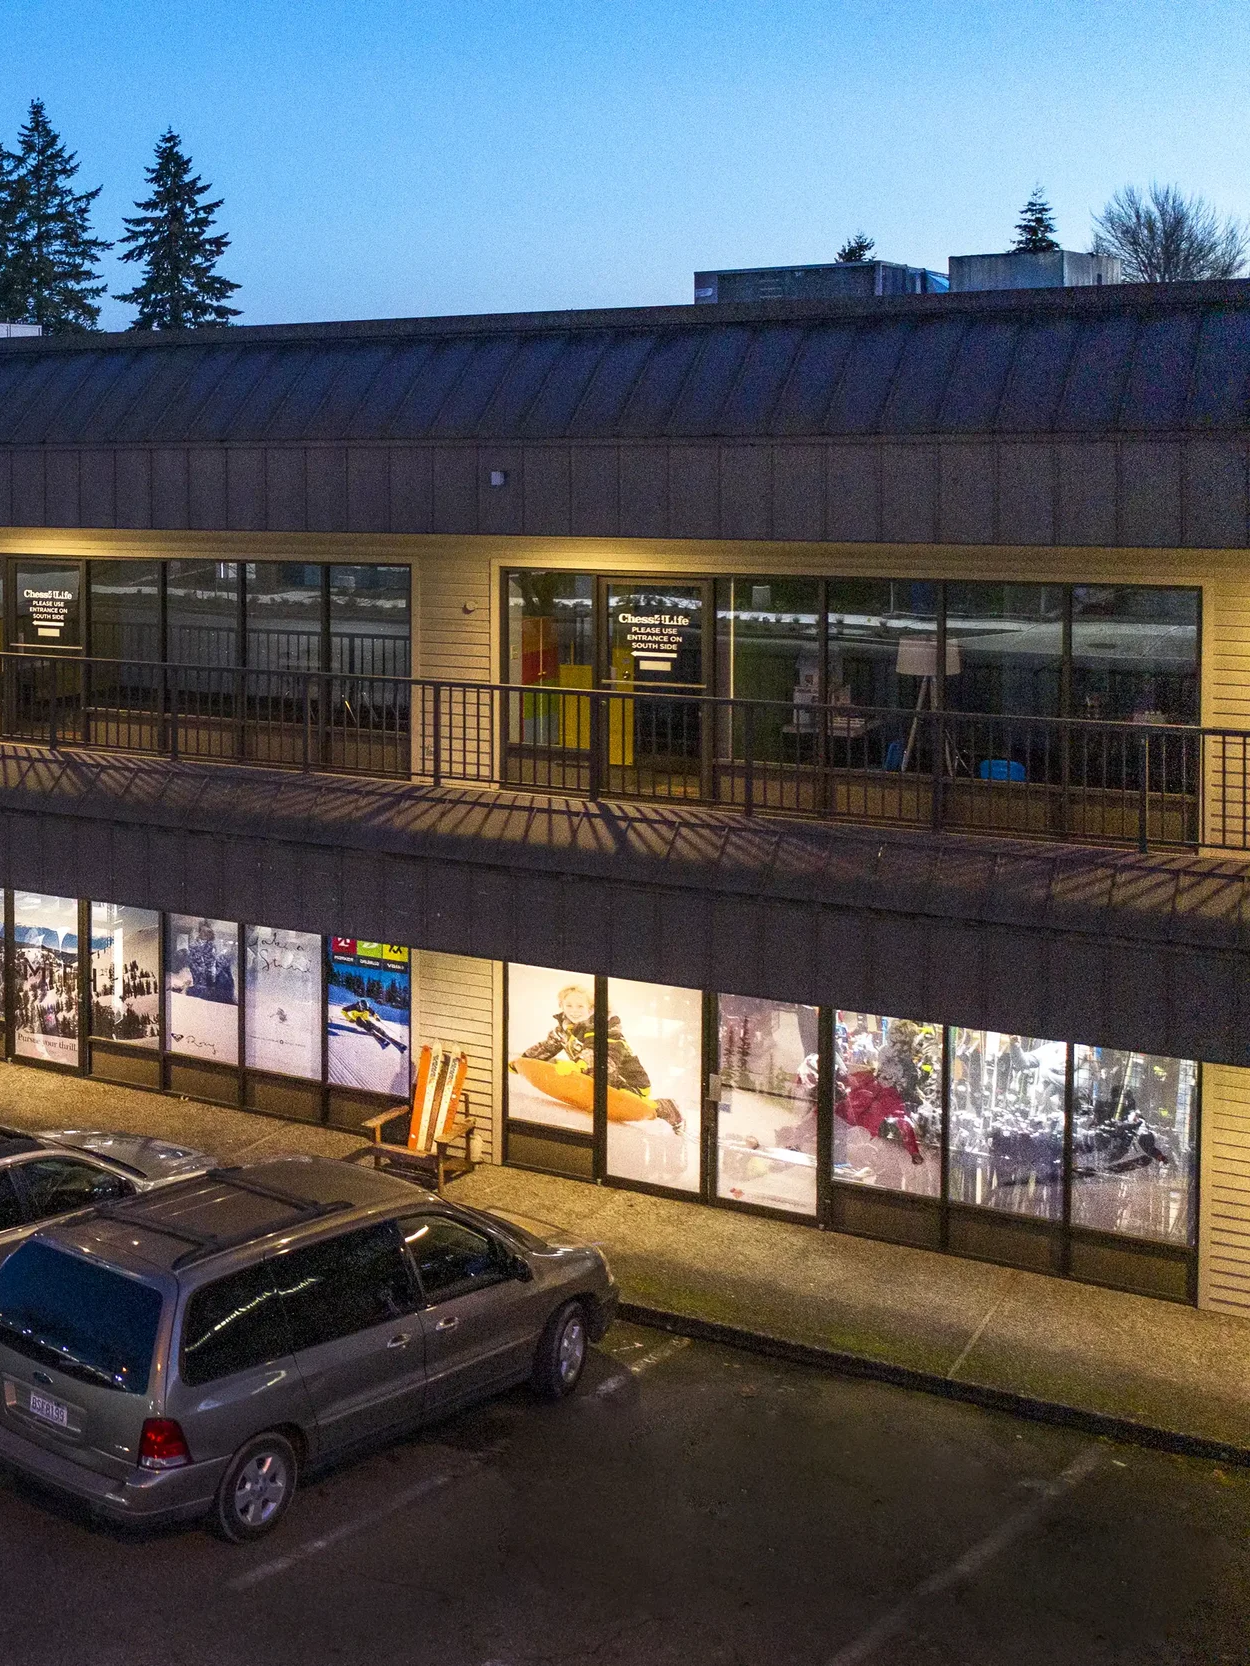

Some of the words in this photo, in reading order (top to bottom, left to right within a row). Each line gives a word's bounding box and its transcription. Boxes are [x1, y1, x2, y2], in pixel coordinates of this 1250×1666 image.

[631, 626, 661, 634] PLEASE
[627, 634, 669, 642] ENTRANCE
[670, 635, 683, 643] ON
[659, 643, 678, 651] SIDE
